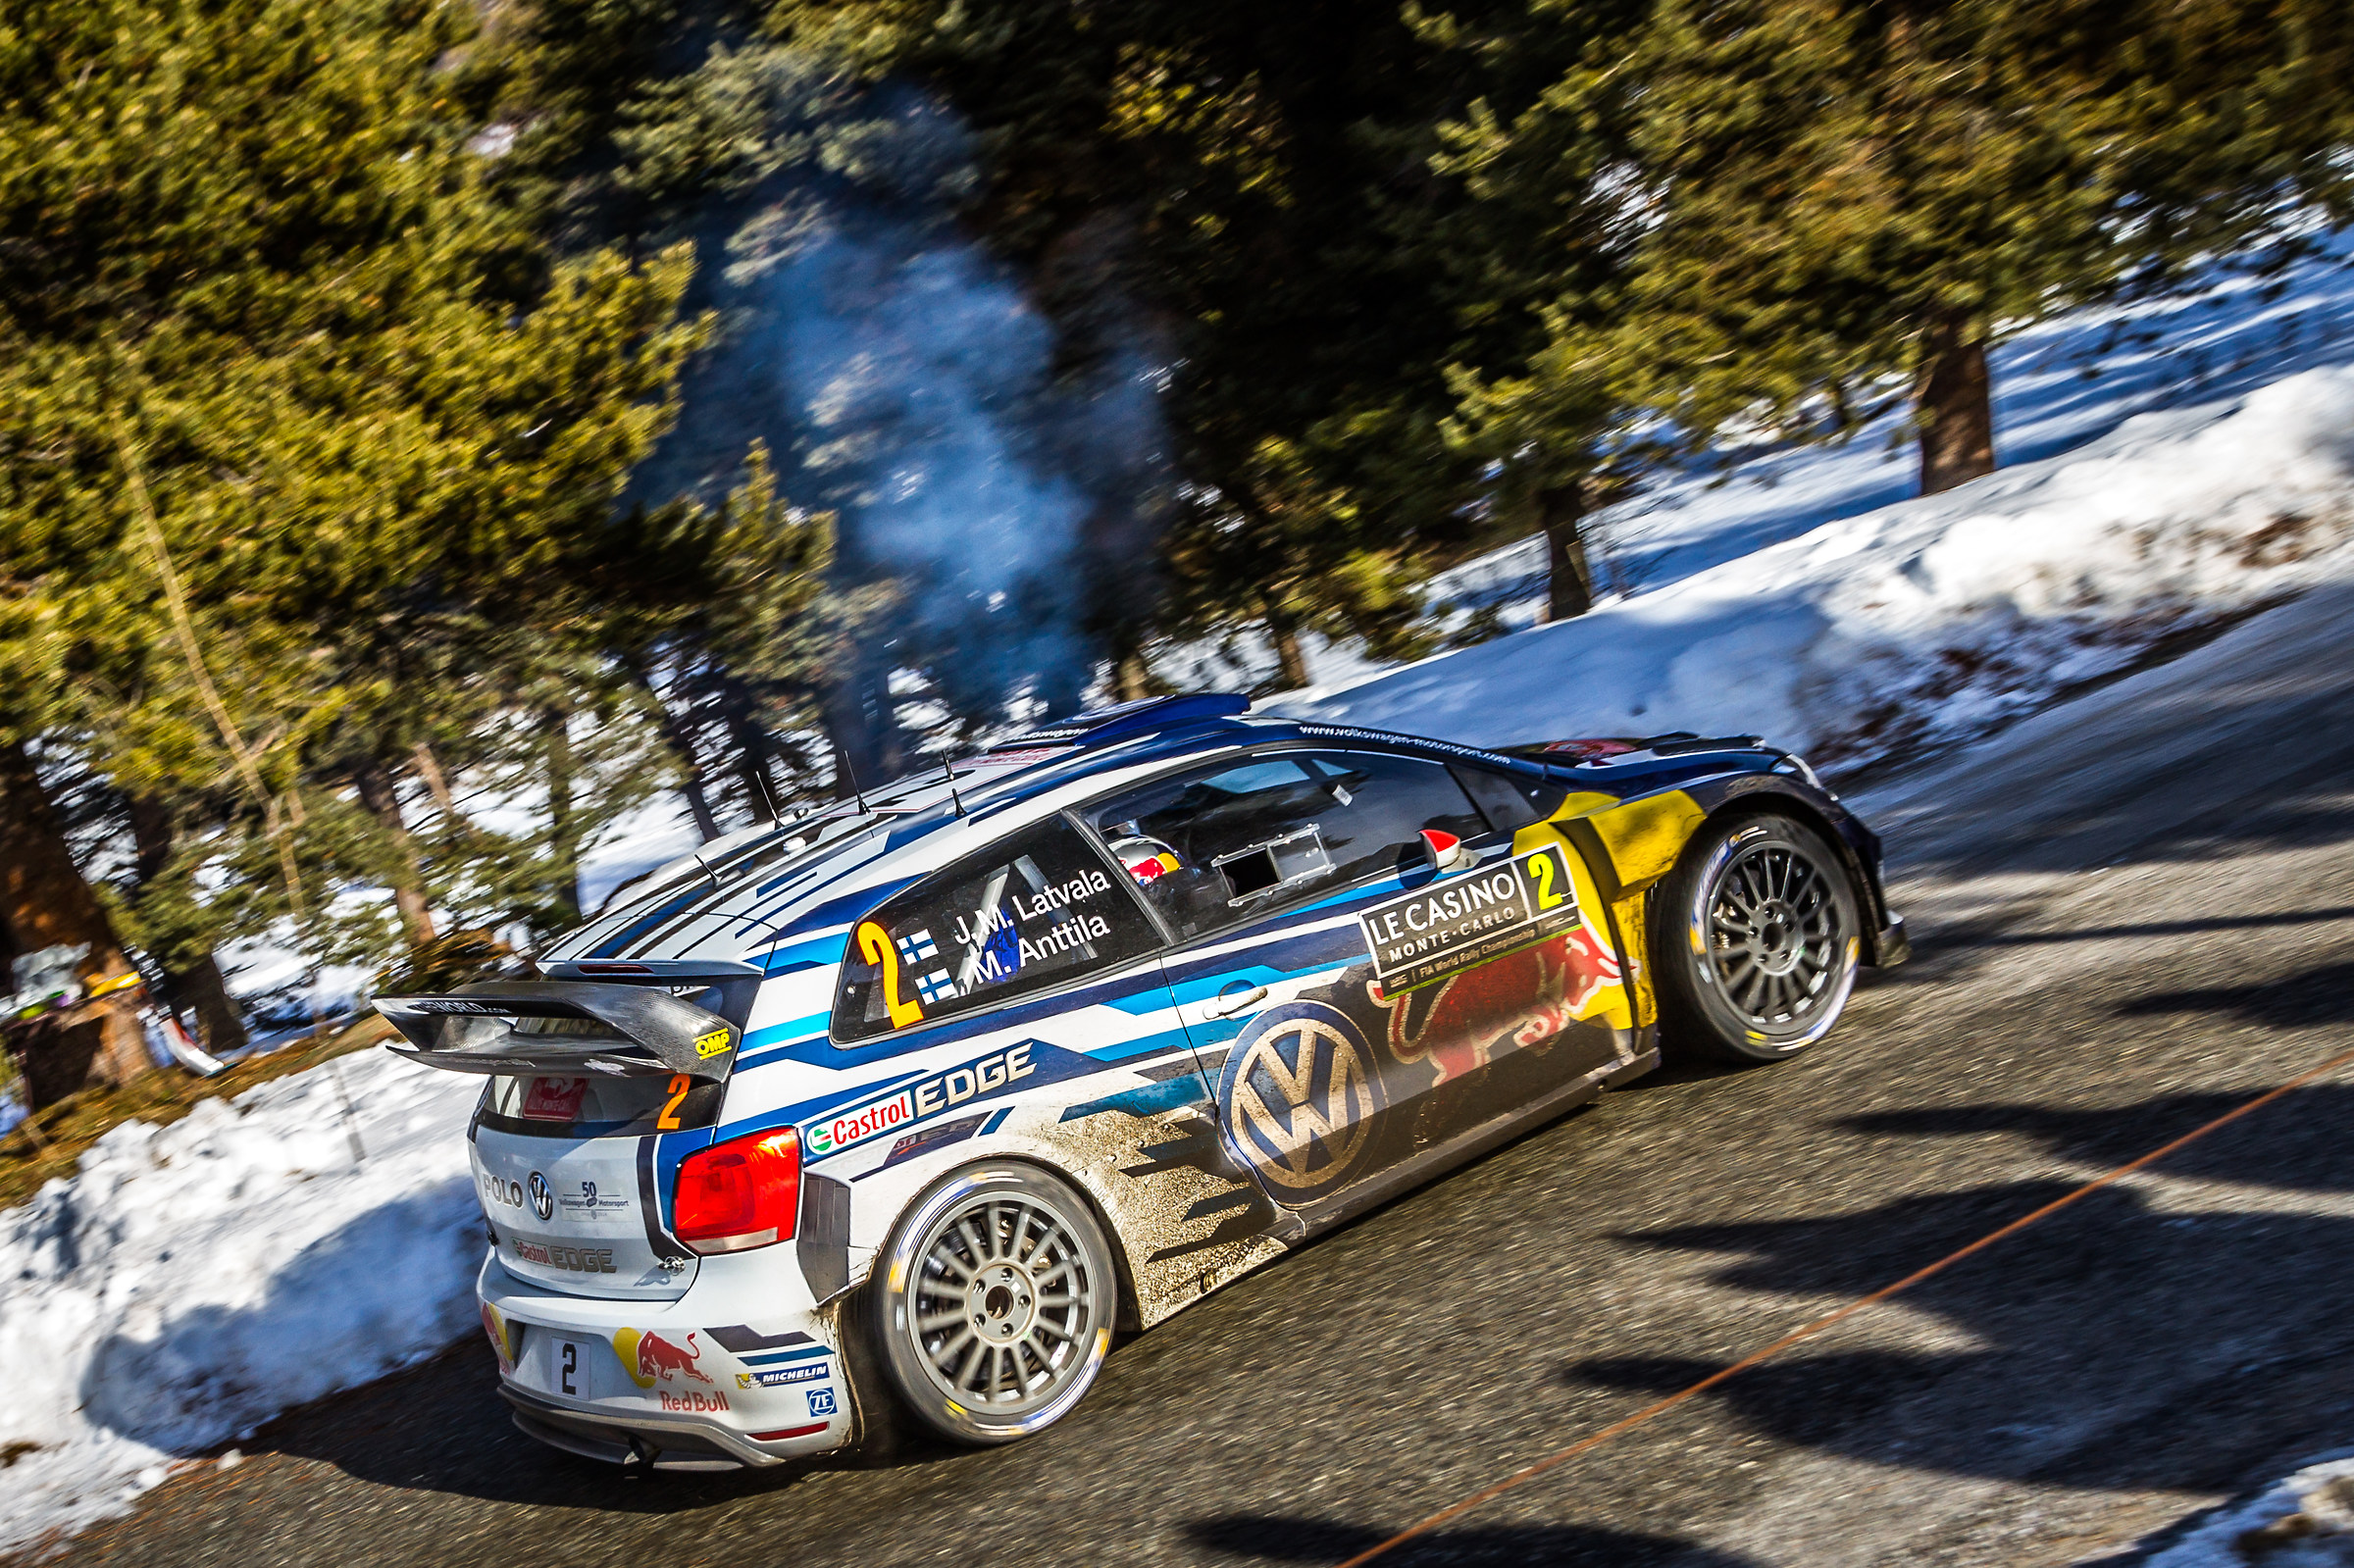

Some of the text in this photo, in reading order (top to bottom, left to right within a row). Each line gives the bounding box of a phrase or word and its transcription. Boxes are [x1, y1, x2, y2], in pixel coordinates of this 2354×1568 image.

[1012, 870, 1111, 921] Latvala
[1526, 853, 1563, 910] 2
[1369, 873, 1515, 945] LE CASINO
[857, 921, 924, 1029] 2
[969, 914, 1110, 985] M. Anttila
[1419, 928, 1536, 979] FIA World Rally Championship
[695, 1033, 730, 1055] OMP
[656, 1073, 691, 1129] 2
[834, 1096, 910, 1145] Castrol
[915, 1041, 1038, 1118] EDGE
[484, 1173, 524, 1209] POLO
[582, 1181, 597, 1197] 50
[598, 1198, 630, 1208] Motorsport
[519, 1239, 618, 1274] Castrol EDGE
[562, 1342, 577, 1395] 2
[762, 1365, 827, 1383] MICHELIN
[811, 1393, 831, 1411] ZF
